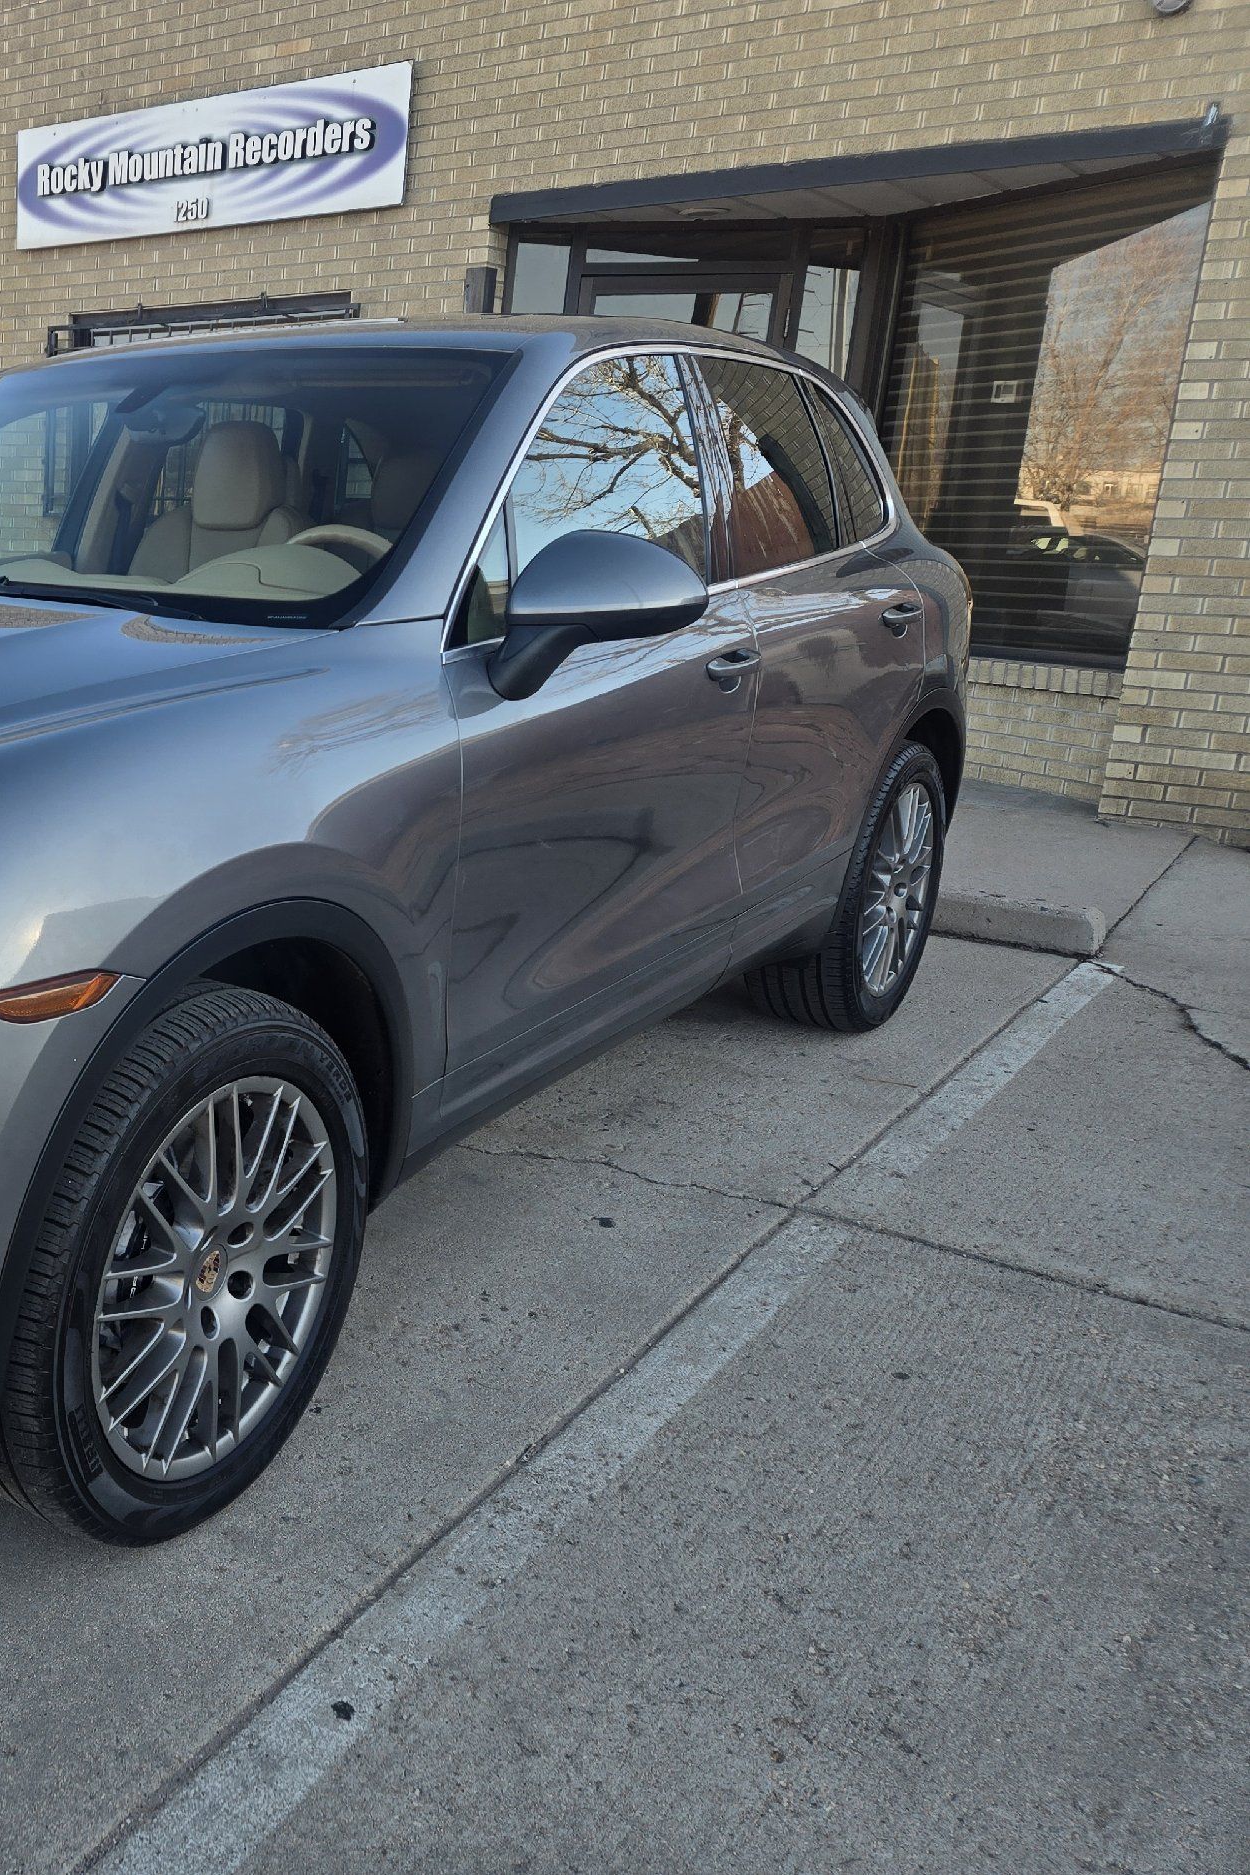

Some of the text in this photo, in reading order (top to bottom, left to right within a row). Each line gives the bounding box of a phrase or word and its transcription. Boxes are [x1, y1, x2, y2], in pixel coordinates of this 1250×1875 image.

[37, 118, 376, 197] Rocky Mountain Recorders
[173, 196, 210, 223] 1250
